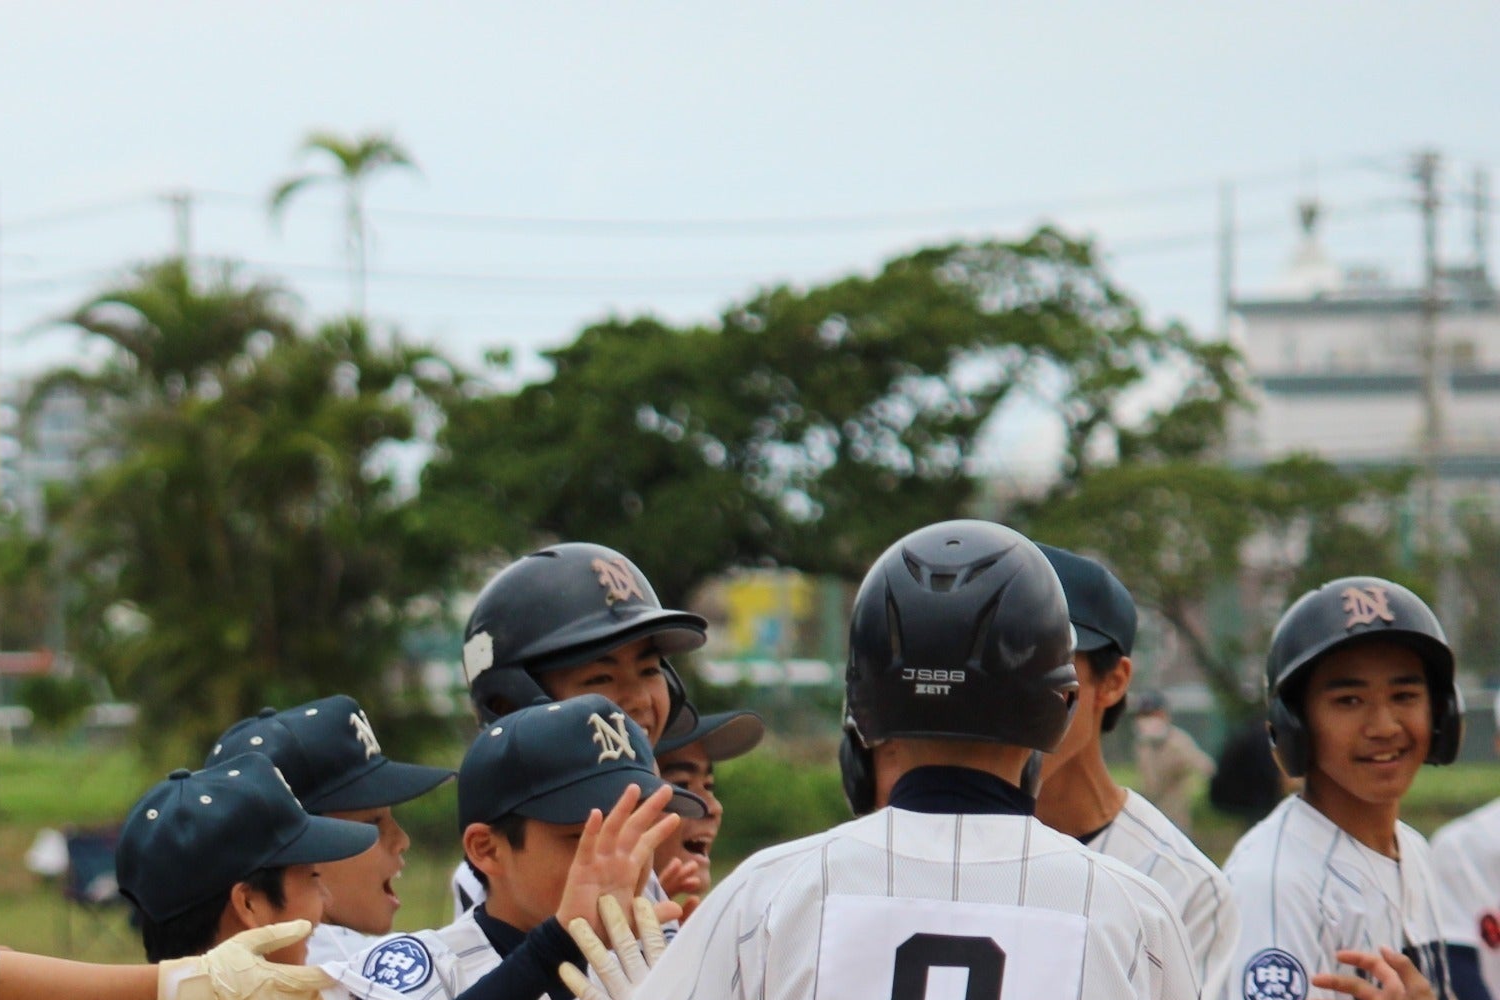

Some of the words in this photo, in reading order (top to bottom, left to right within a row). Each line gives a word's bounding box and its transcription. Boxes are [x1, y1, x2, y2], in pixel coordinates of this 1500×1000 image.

[591, 558, 644, 606] N
[1341, 587, 1395, 628] N
[915, 683, 951, 694] ZETT
[588, 712, 636, 764] N
